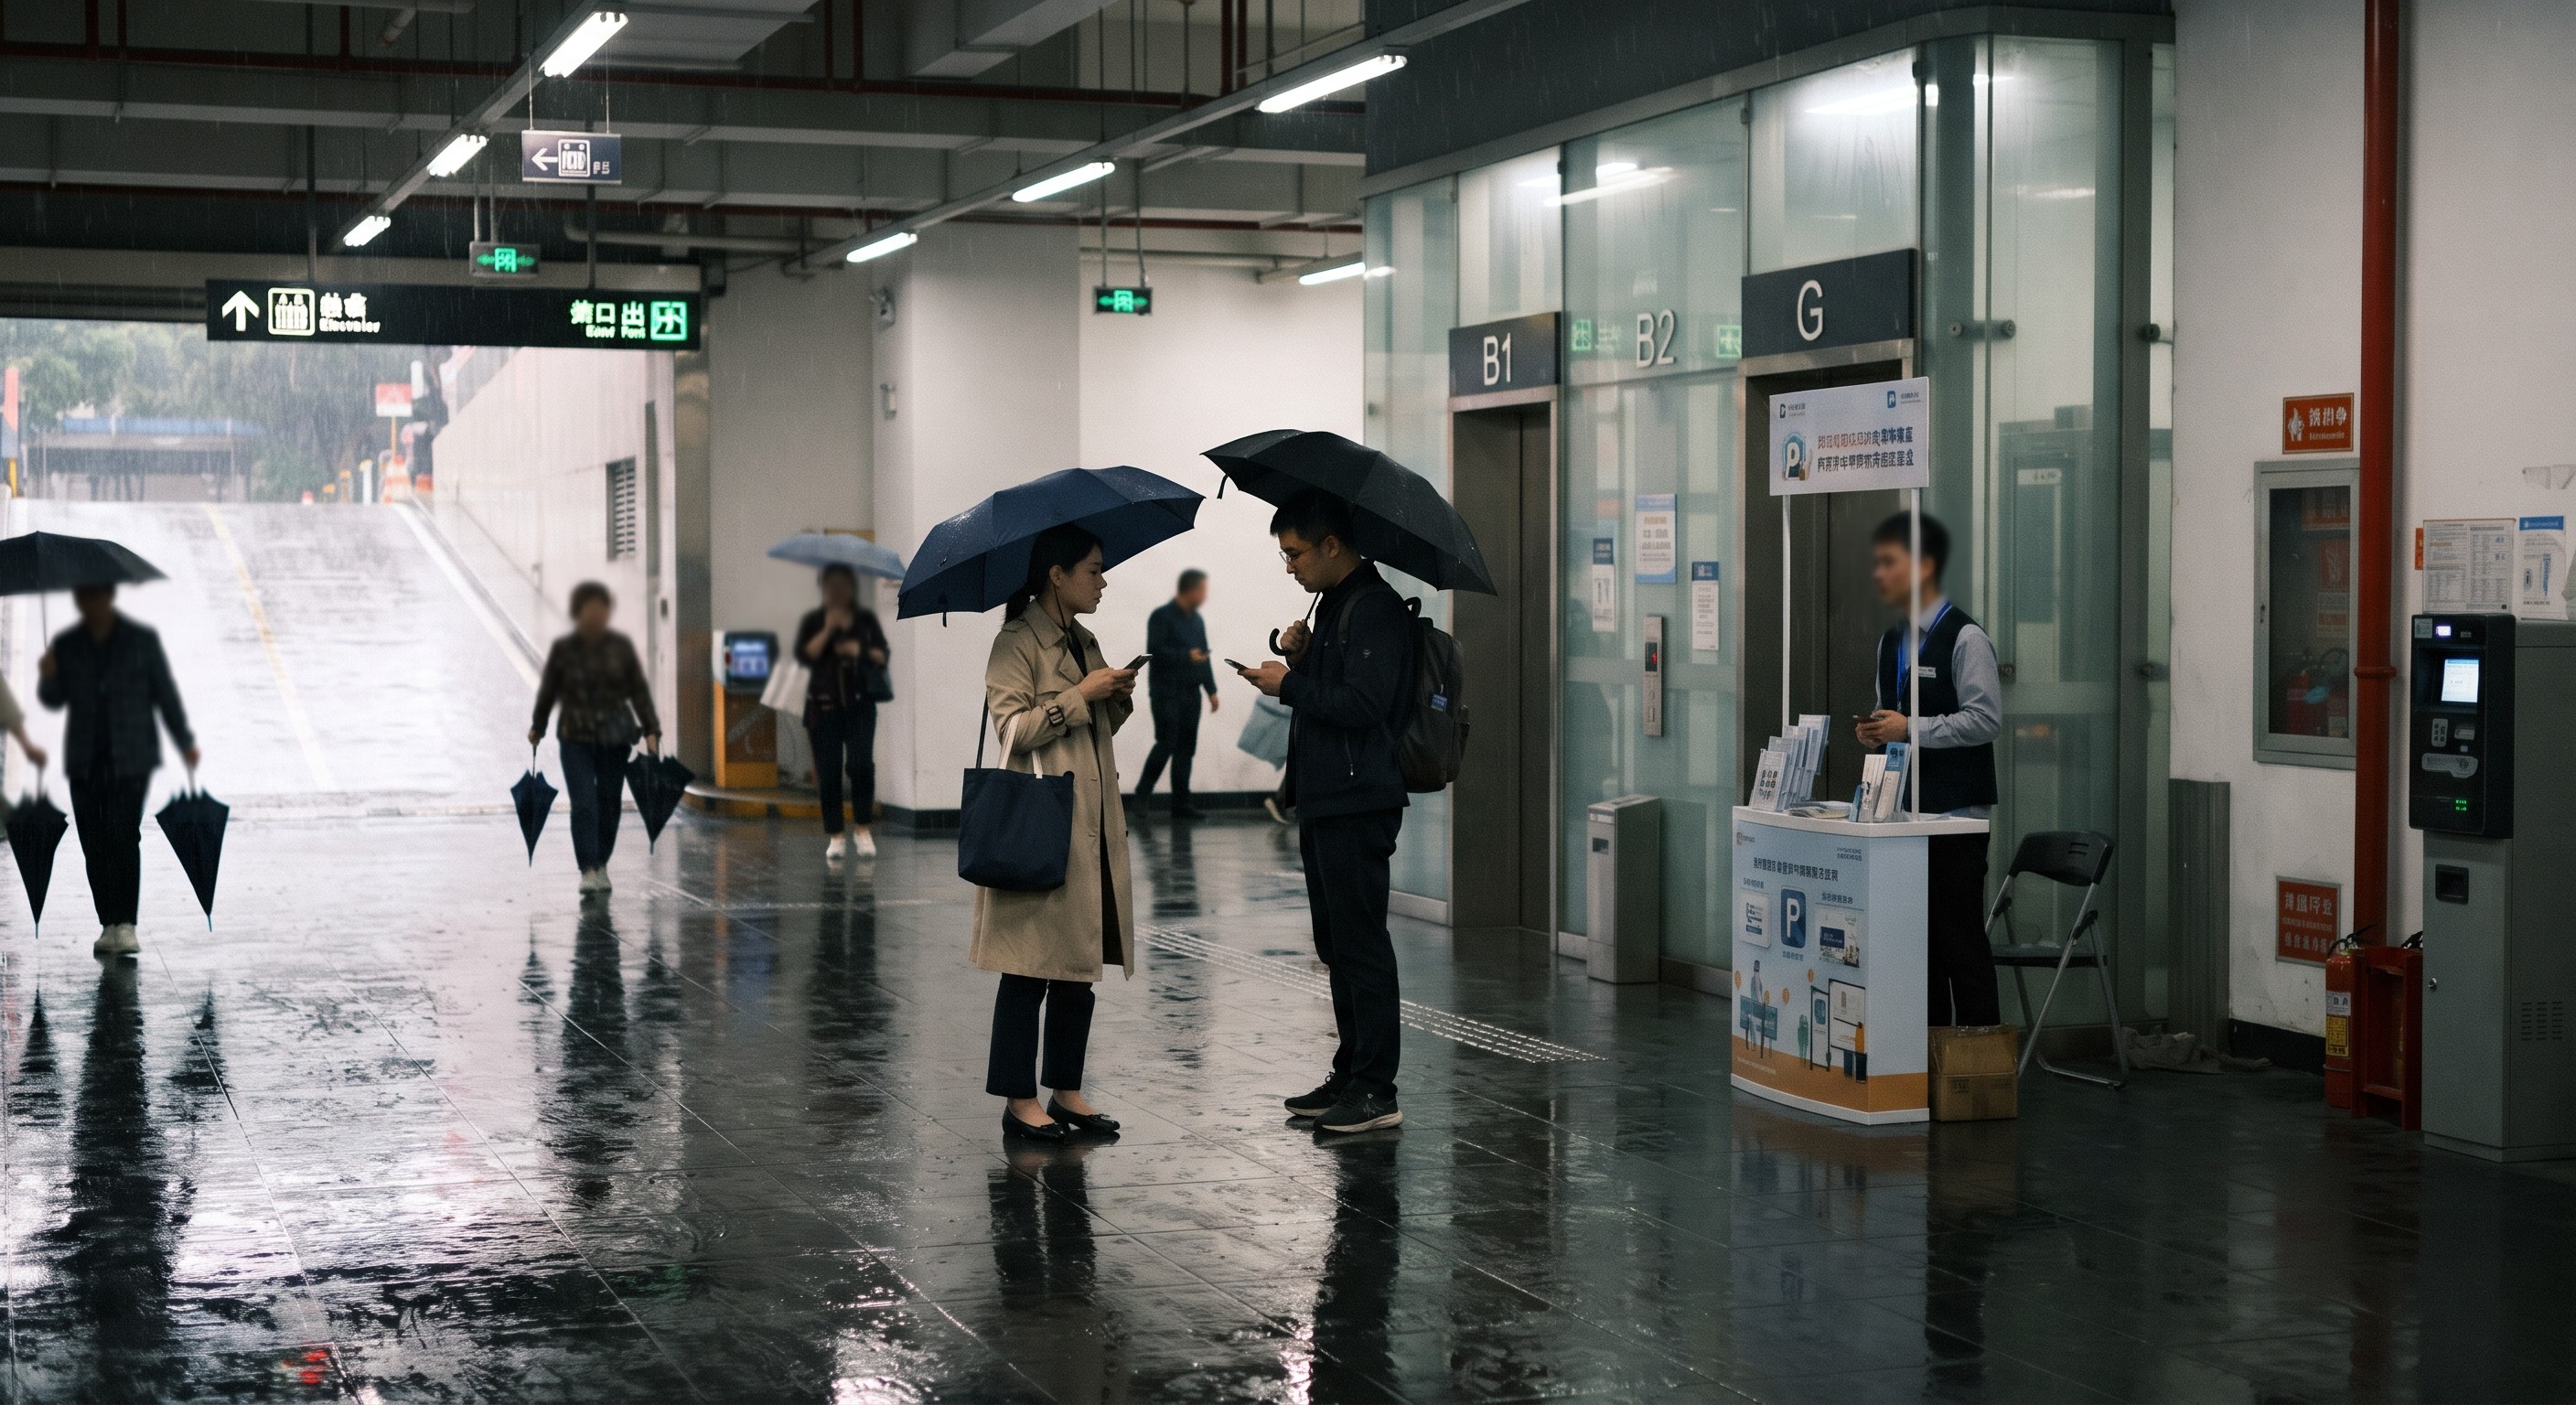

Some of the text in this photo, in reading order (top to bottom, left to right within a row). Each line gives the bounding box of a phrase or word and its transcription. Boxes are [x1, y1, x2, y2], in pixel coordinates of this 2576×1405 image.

[1637, 308, 1675, 369] B2
[1797, 278, 1825, 342] G
[1483, 331, 1512, 386] B1
[1787, 897, 1800, 938] P
